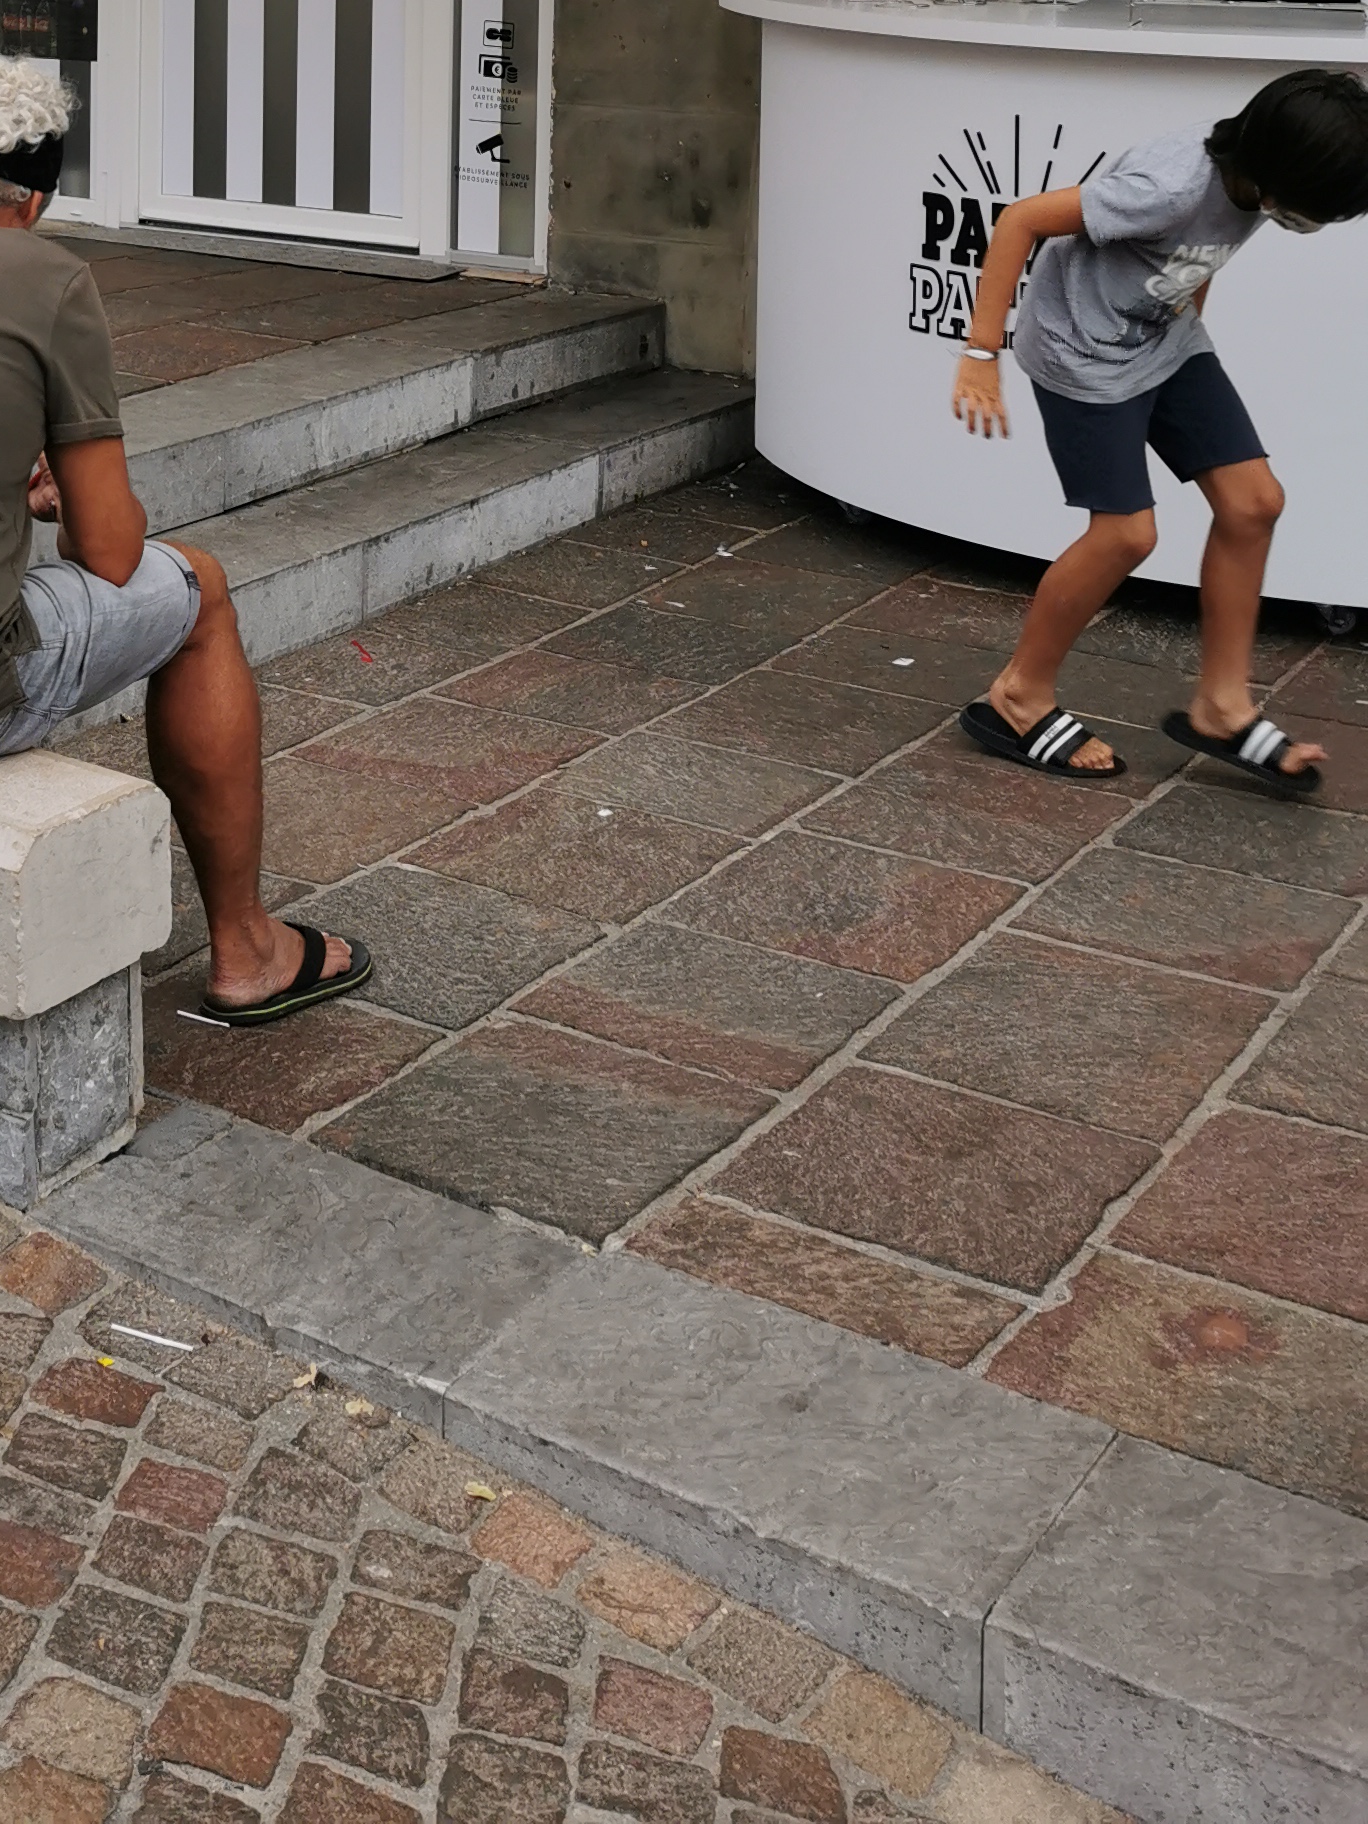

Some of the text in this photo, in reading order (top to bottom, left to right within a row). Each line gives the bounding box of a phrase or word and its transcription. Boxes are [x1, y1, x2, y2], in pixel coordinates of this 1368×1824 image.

[472, 93, 519, 104] CARTE BLEUE
[455, 174, 528, 189] IDEOSURVELLANCE
